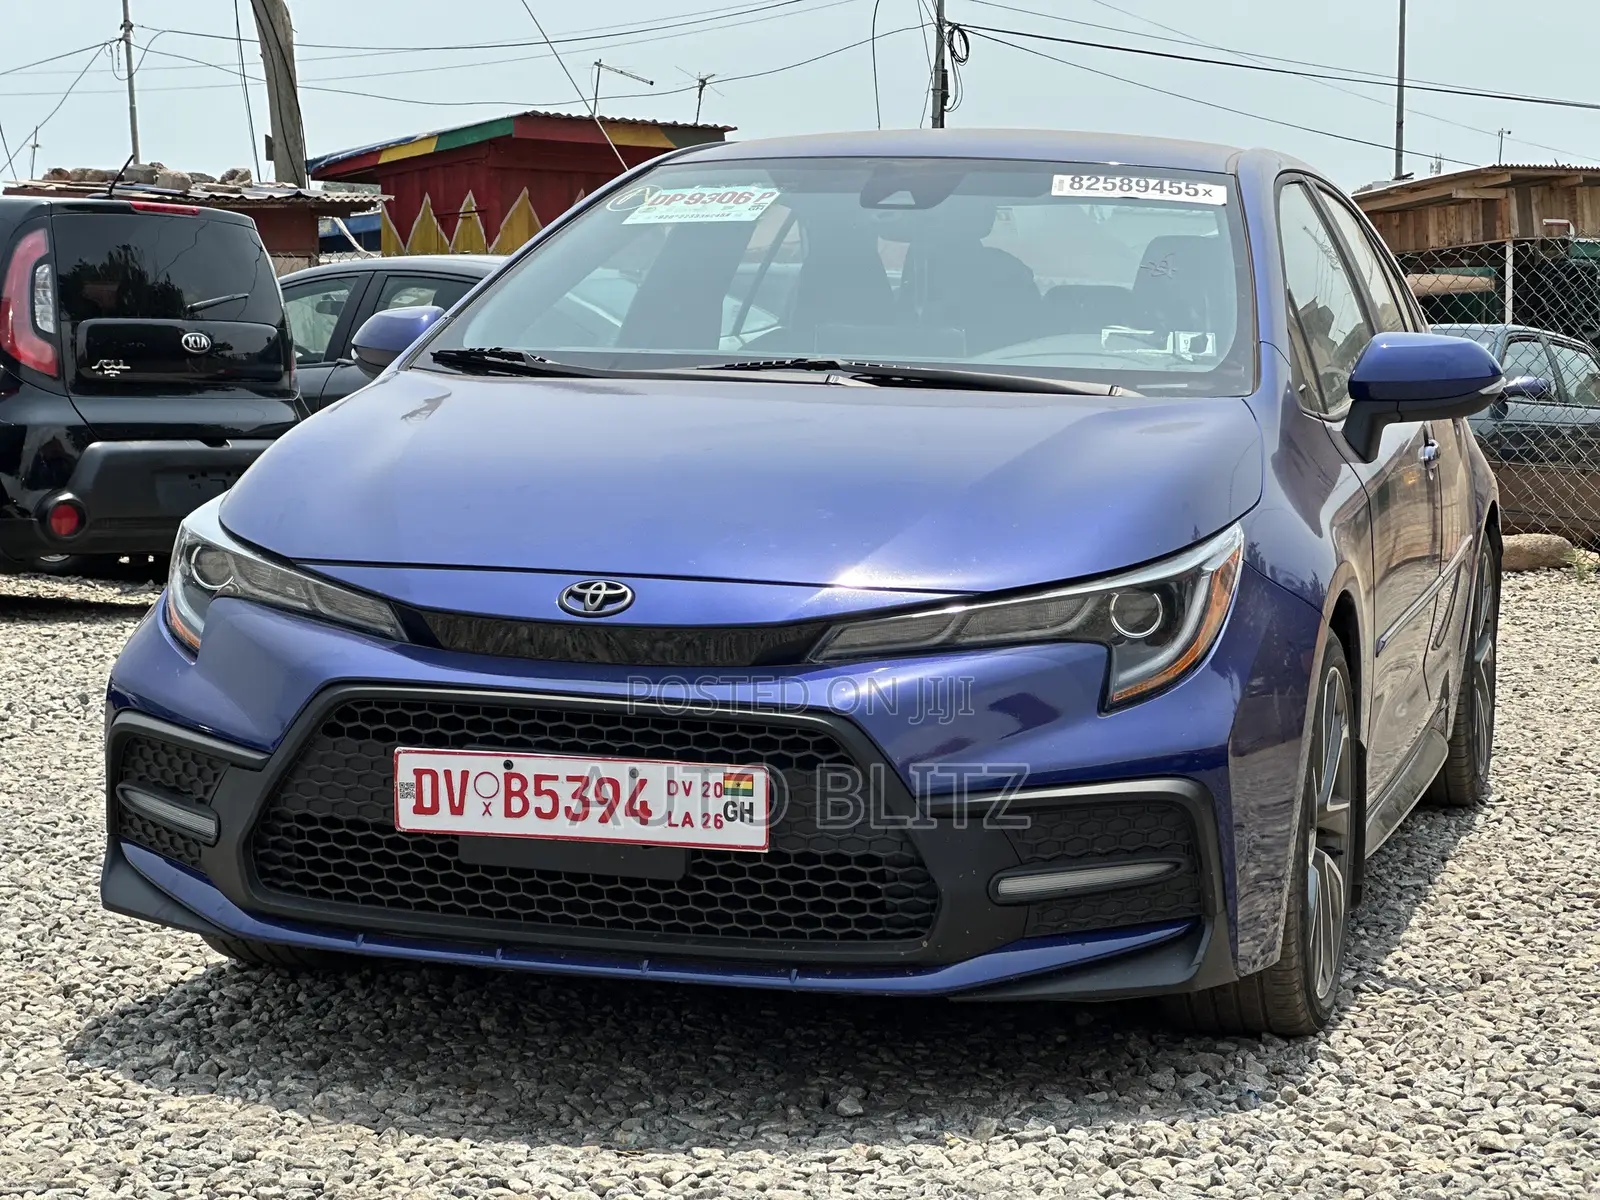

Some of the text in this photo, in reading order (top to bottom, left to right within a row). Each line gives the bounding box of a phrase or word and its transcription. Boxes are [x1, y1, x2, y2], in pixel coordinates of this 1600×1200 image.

[684, 191, 755, 205] 9306
[754, 191, 777, 204] P
[187, 336, 208, 348] KIA
[413, 768, 652, 826] DV B5394
[667, 779, 723, 799] DV 20
[667, 811, 724, 829] LA 26
[723, 800, 754, 823] GH
